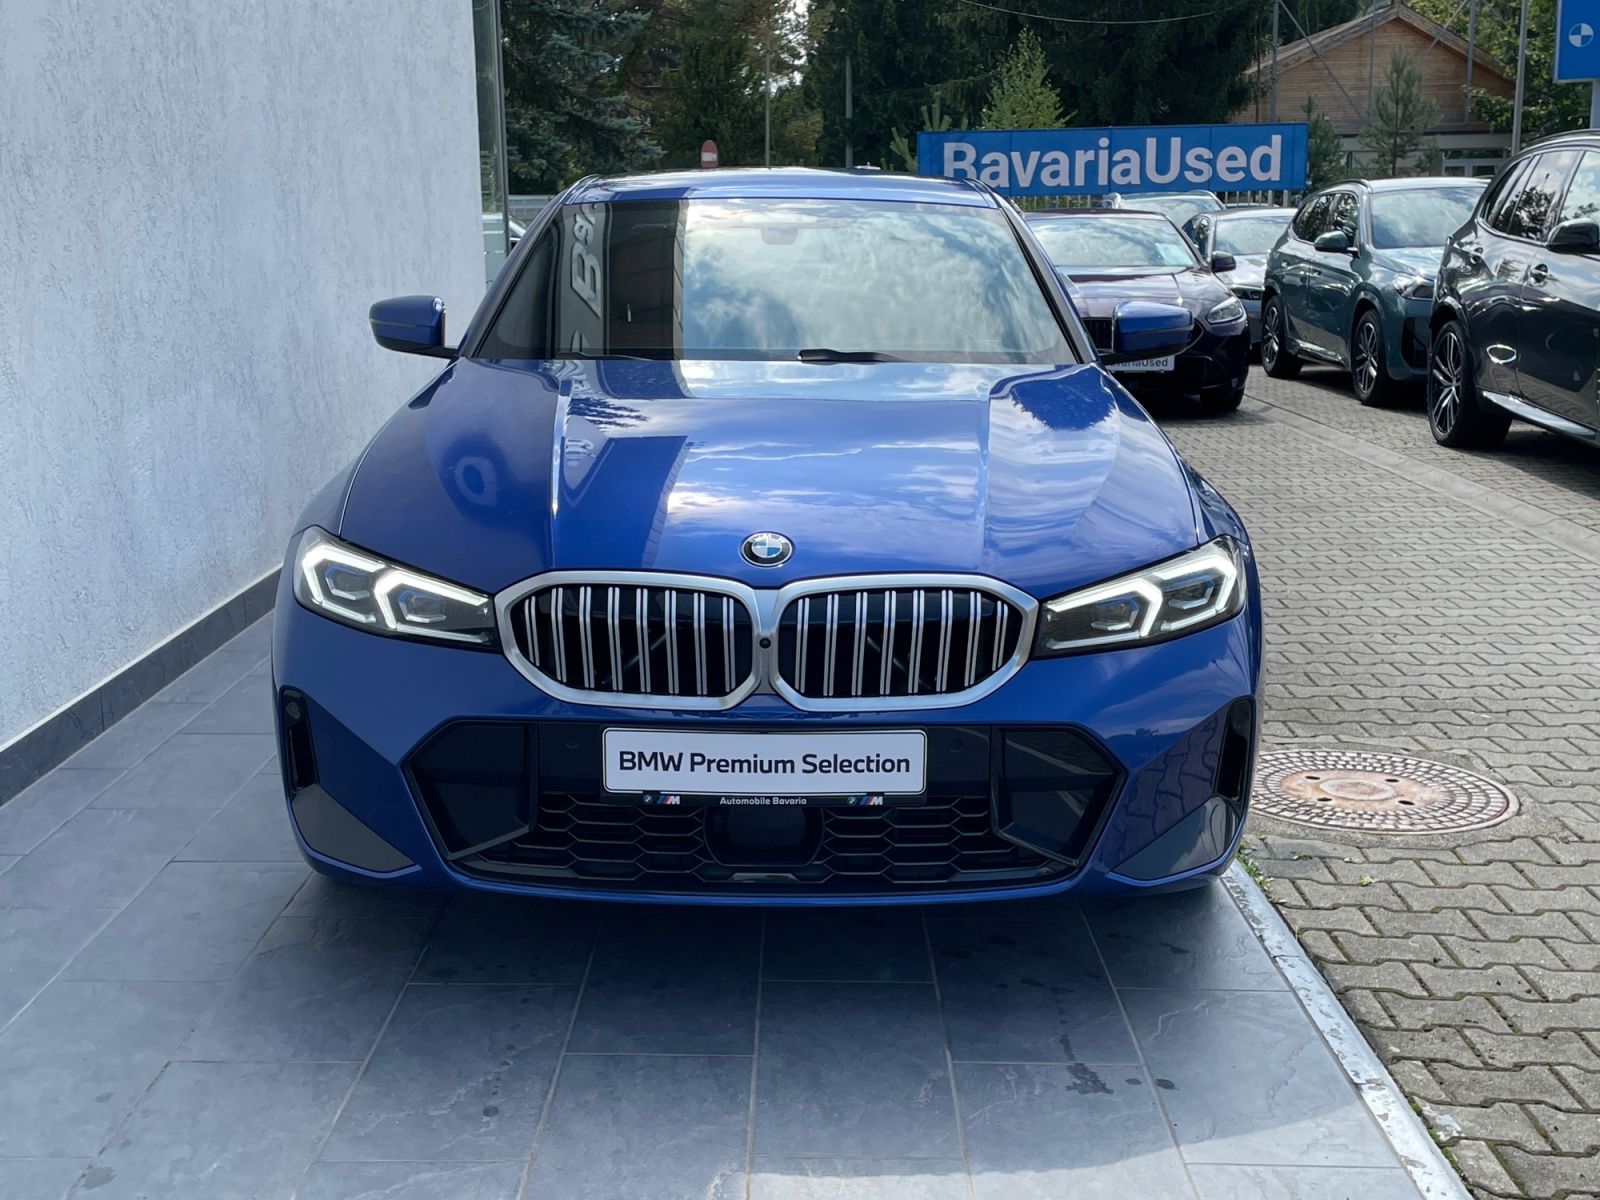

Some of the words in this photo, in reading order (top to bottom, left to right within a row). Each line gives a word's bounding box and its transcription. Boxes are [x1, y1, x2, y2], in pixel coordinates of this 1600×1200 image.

[943, 134, 1282, 188] BavariaUsed
[619, 751, 683, 771] BMW
[690, 753, 795, 774] Premium
[802, 754, 910, 773] Selection
[720, 797, 770, 805] Automobile
[772, 797, 807, 805] Bavaria
